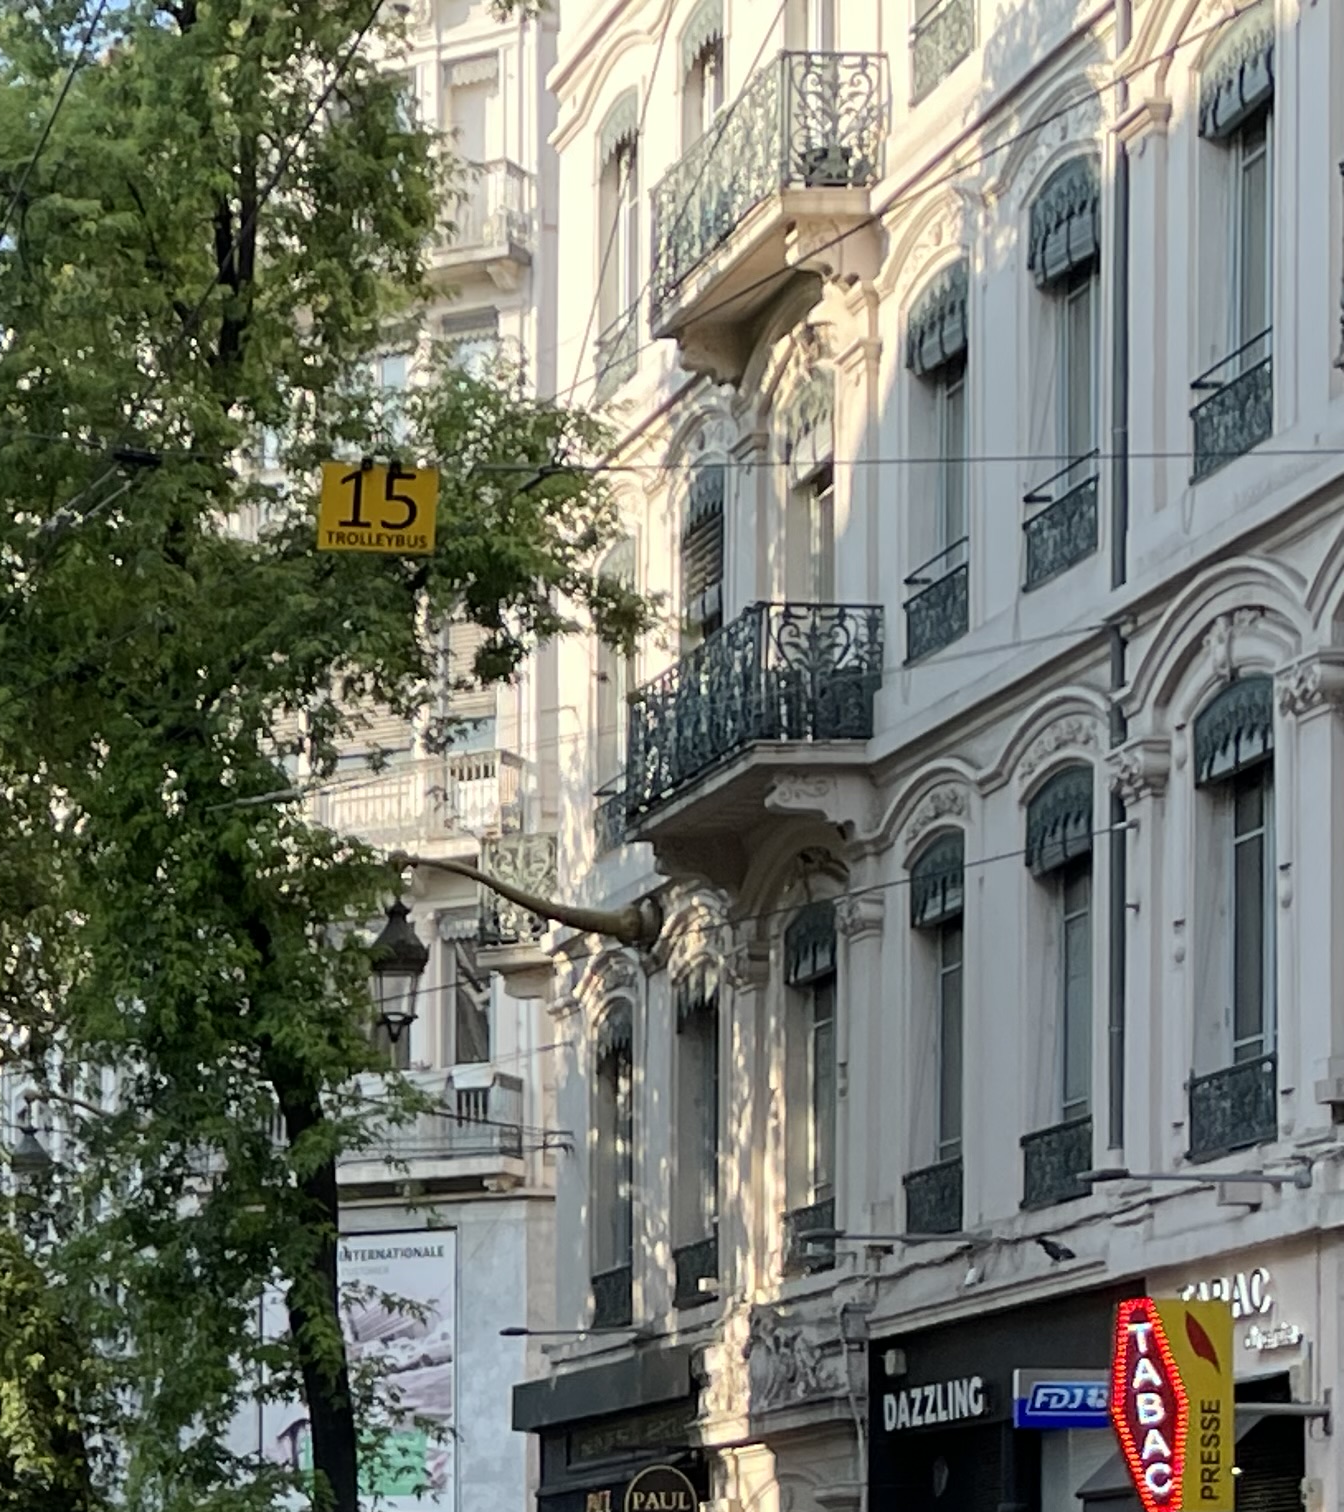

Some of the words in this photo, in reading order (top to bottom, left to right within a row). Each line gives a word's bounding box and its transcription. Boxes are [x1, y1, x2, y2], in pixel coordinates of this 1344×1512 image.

[338, 470, 417, 529] 15
[326, 531, 428, 549] TROLLEYBUS
[883, 1376, 983, 1432] DAZZLING
[1034, 1387, 1084, 1410] FDJ
[1127, 1322, 1172, 1493] TABAC
[1200, 1399, 1221, 1501] PRESSE
[632, 1491, 691, 1511] PAUL
